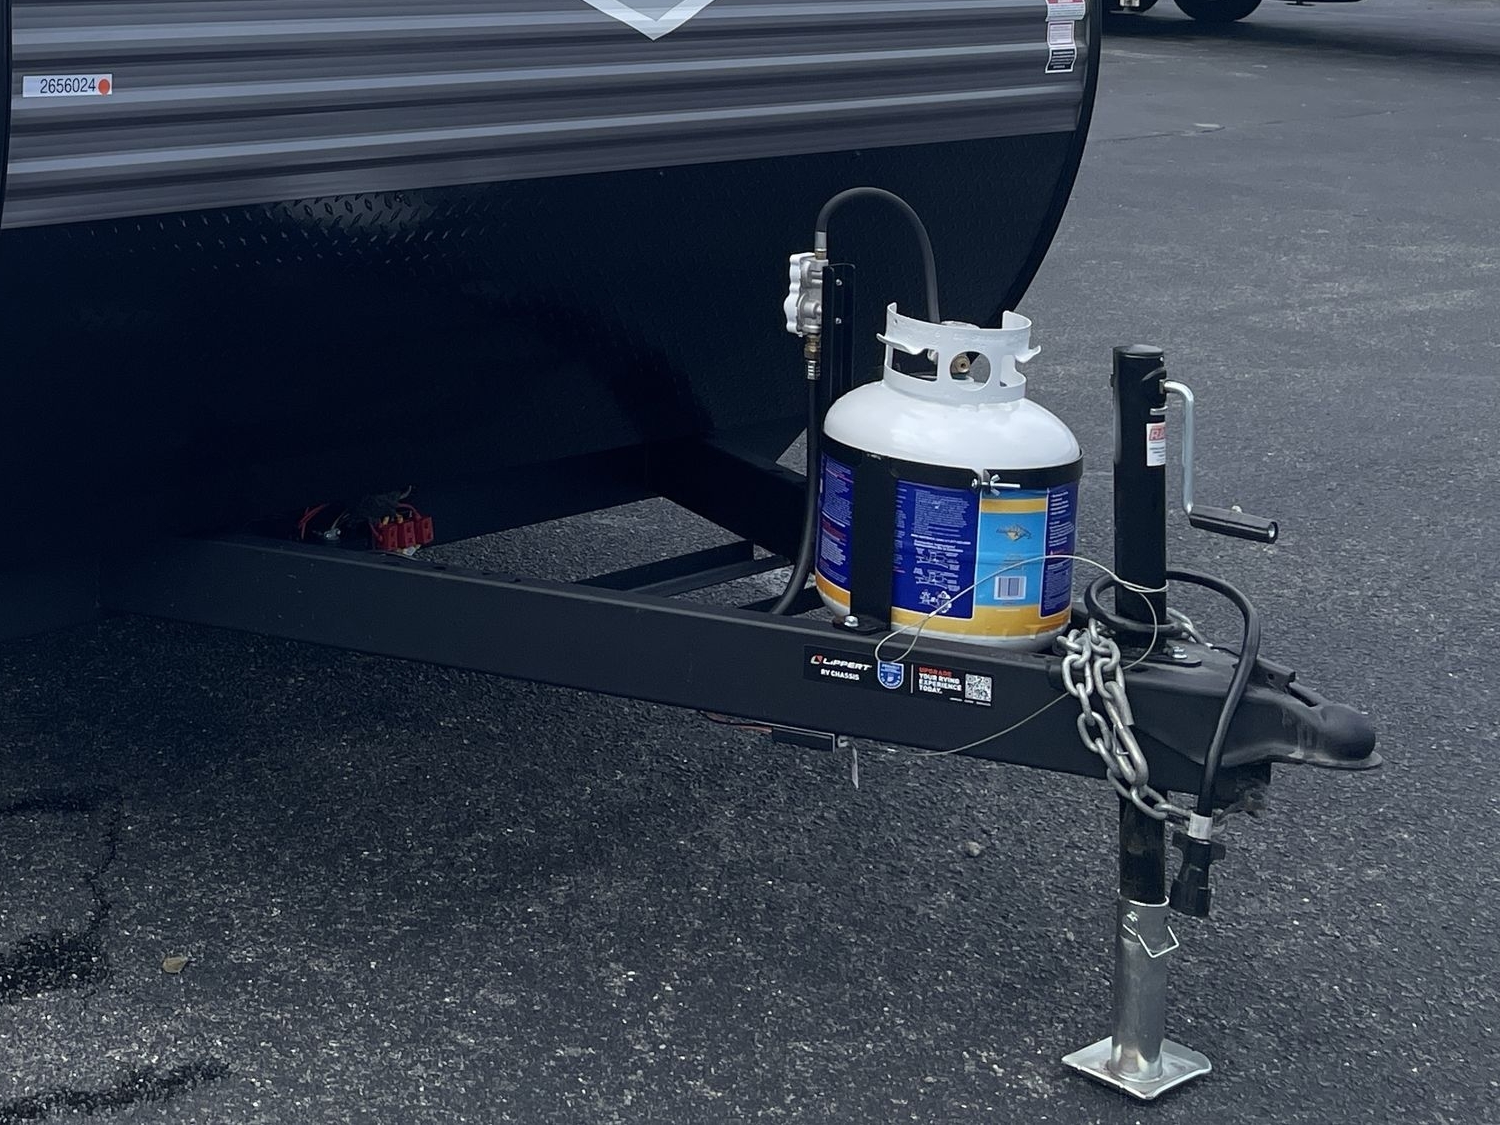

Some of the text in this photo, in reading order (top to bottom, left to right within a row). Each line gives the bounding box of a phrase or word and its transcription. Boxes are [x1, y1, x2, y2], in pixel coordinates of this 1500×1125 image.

[40, 78, 96, 94] 2656024
[823, 658, 872, 671] LIPPERT
[831, 670, 860, 680] CHASSIS
